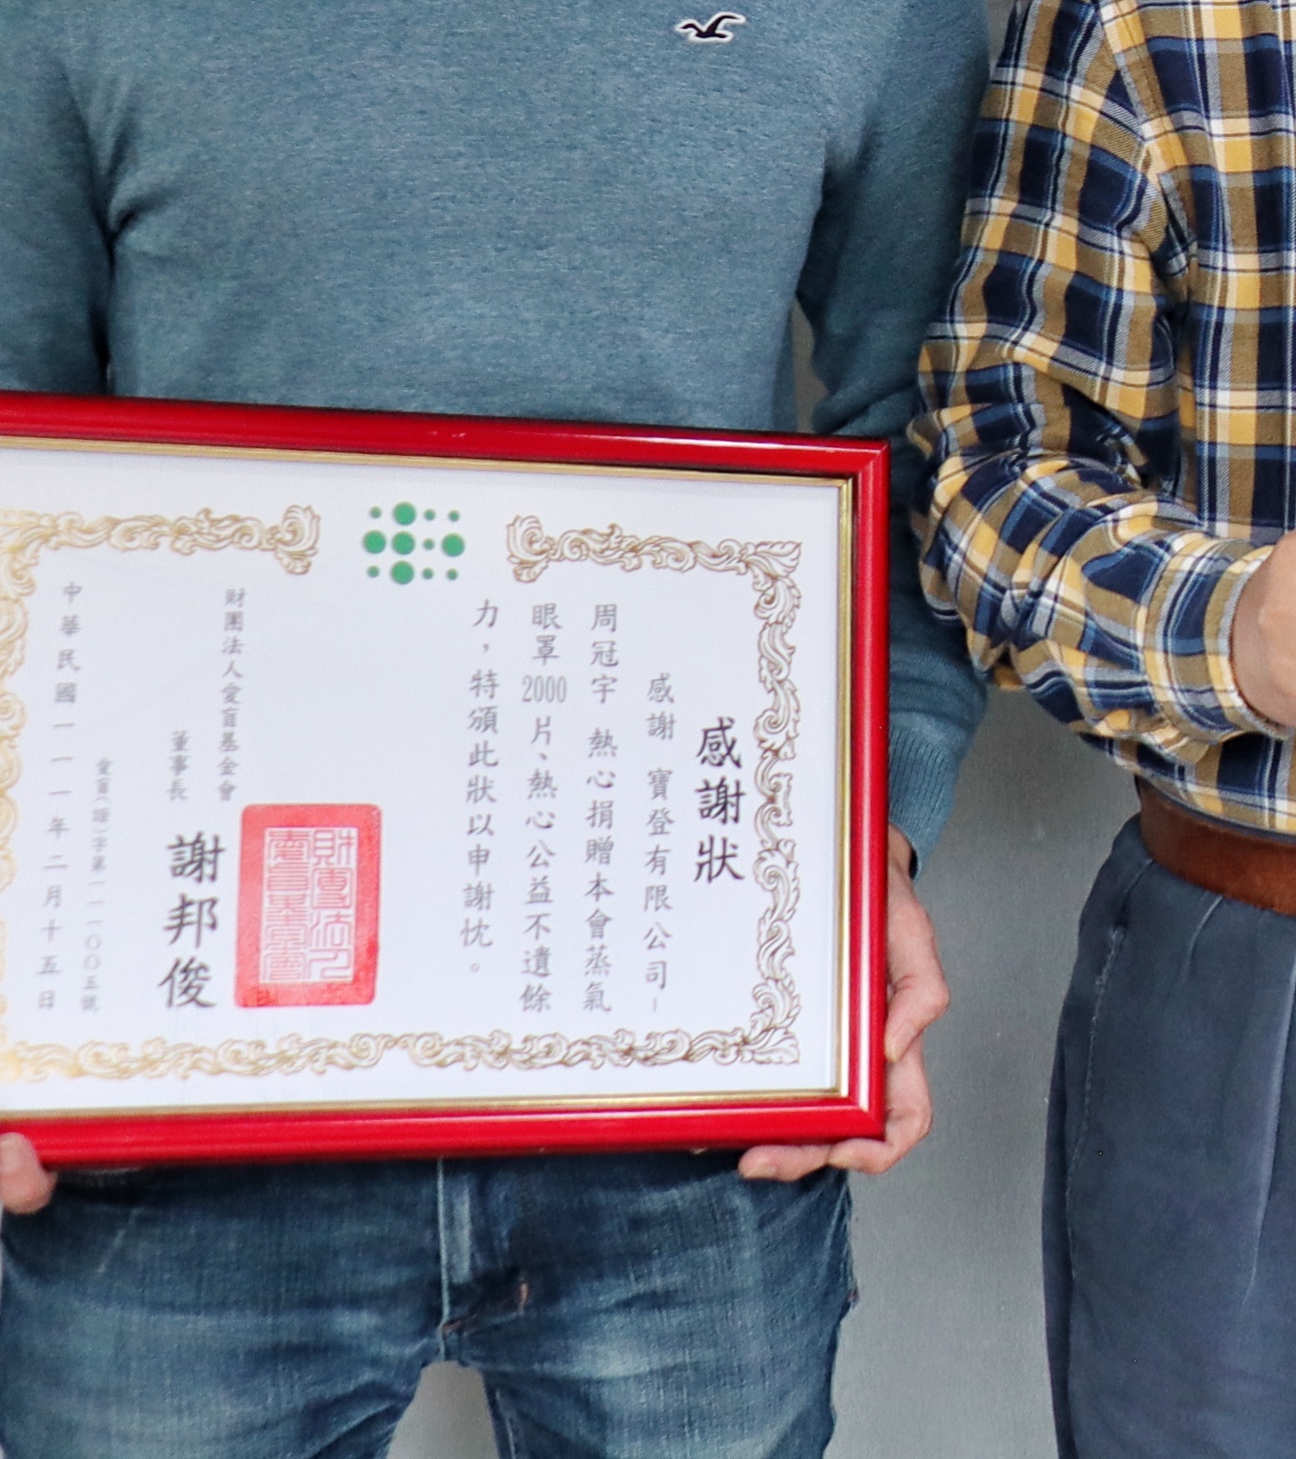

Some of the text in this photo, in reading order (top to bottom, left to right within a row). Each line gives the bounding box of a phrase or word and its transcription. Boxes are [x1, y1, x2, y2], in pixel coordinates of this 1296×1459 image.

[37, 580, 83, 1010] 中華民國一一一年二月十五日
[218, 587, 246, 801] 財團法人愛盲基金會
[583, 604, 619, 1012] 周冠宇 熱心捐贈本會蒸氣
[646, 673, 676, 740] 感謝
[693, 716, 747, 885] 感謝狀
[157, 730, 227, 1010] 董事長 謝邦俊
